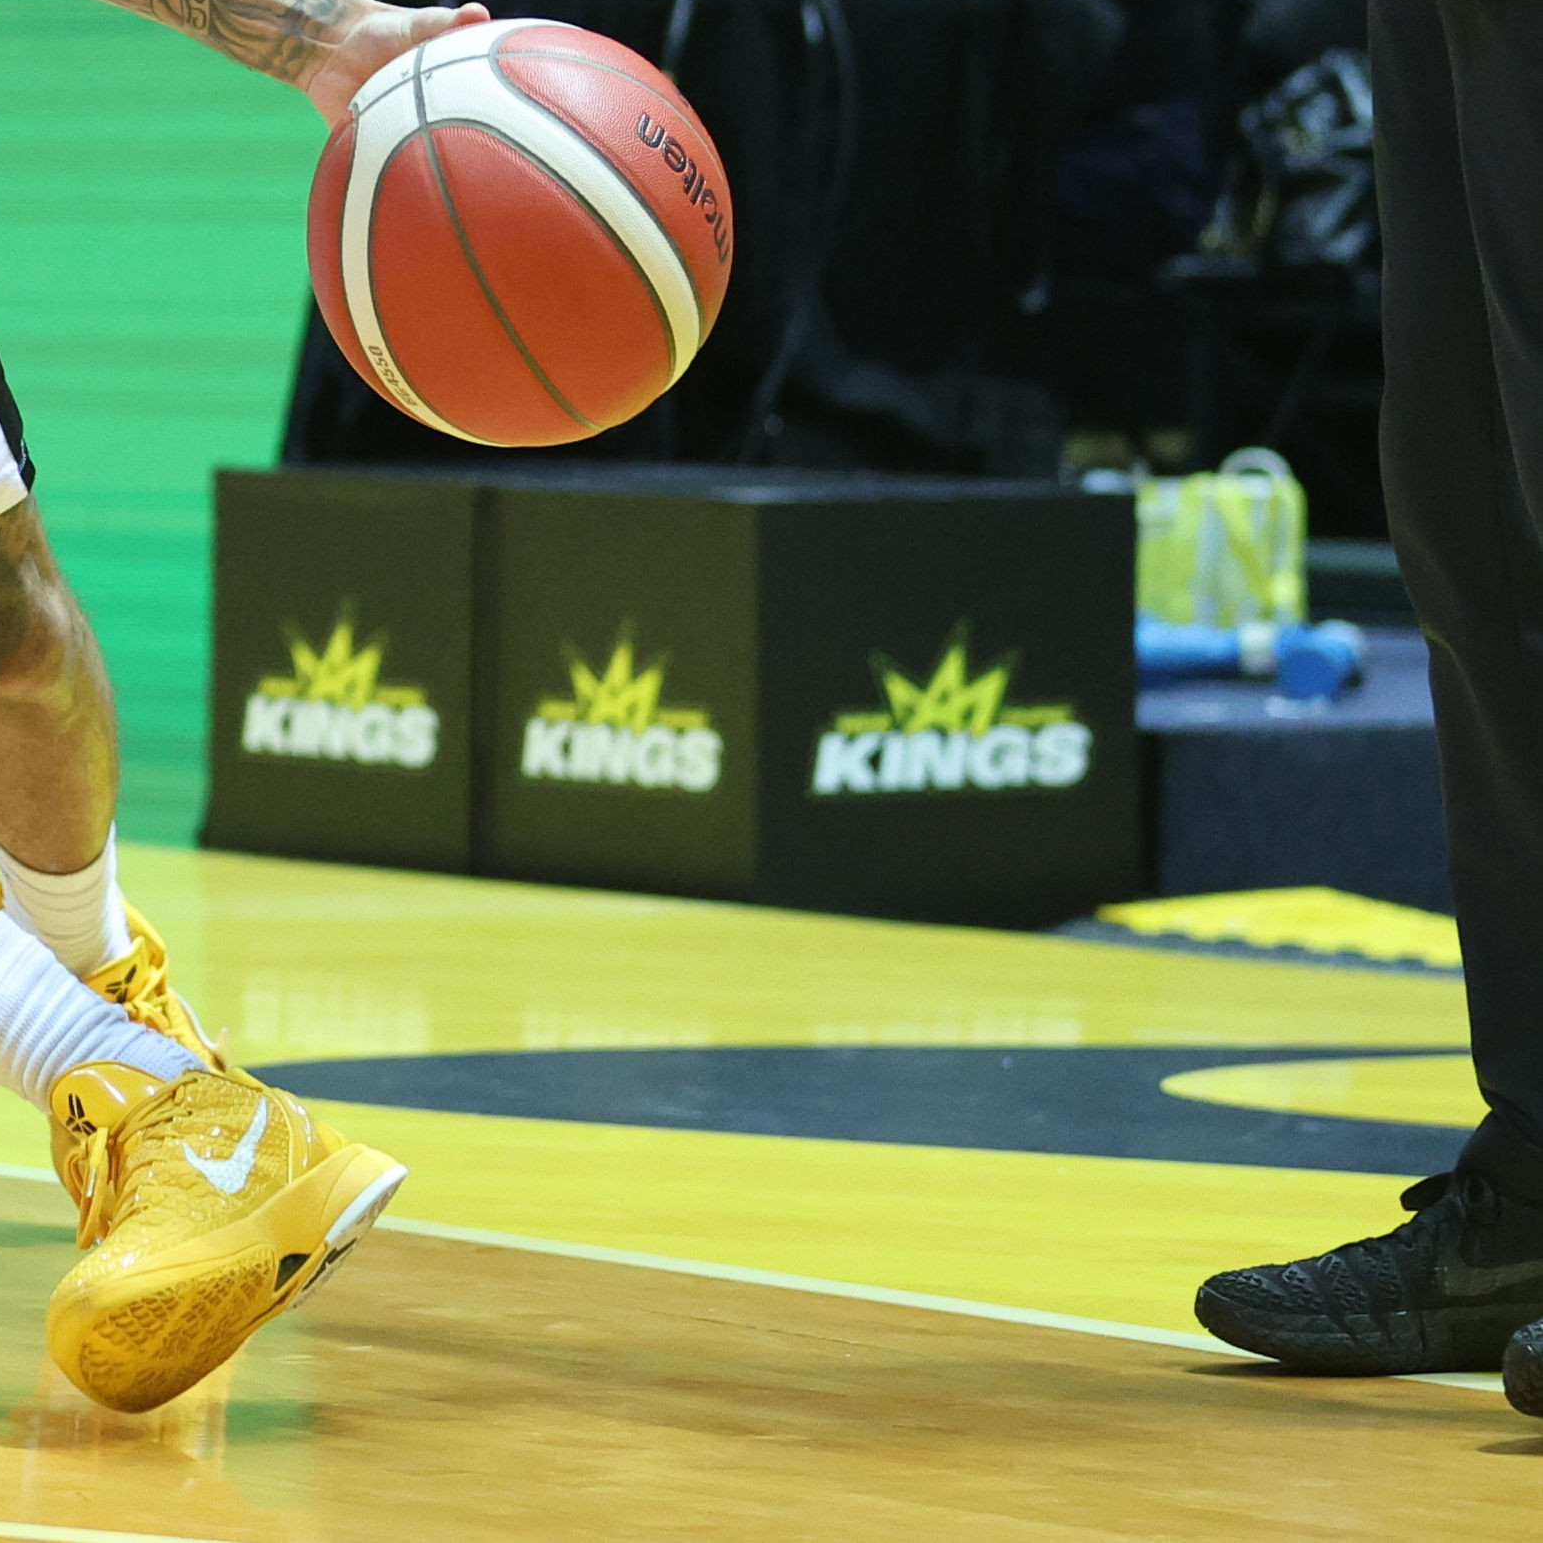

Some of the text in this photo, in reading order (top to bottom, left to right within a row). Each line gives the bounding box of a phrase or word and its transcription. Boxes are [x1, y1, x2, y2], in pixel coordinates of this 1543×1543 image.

[637, 113, 730, 264] molten
[243, 693, 440, 768] KINGS
[522, 717, 722, 792] KINGS
[814, 722, 1092, 794] KINGS
